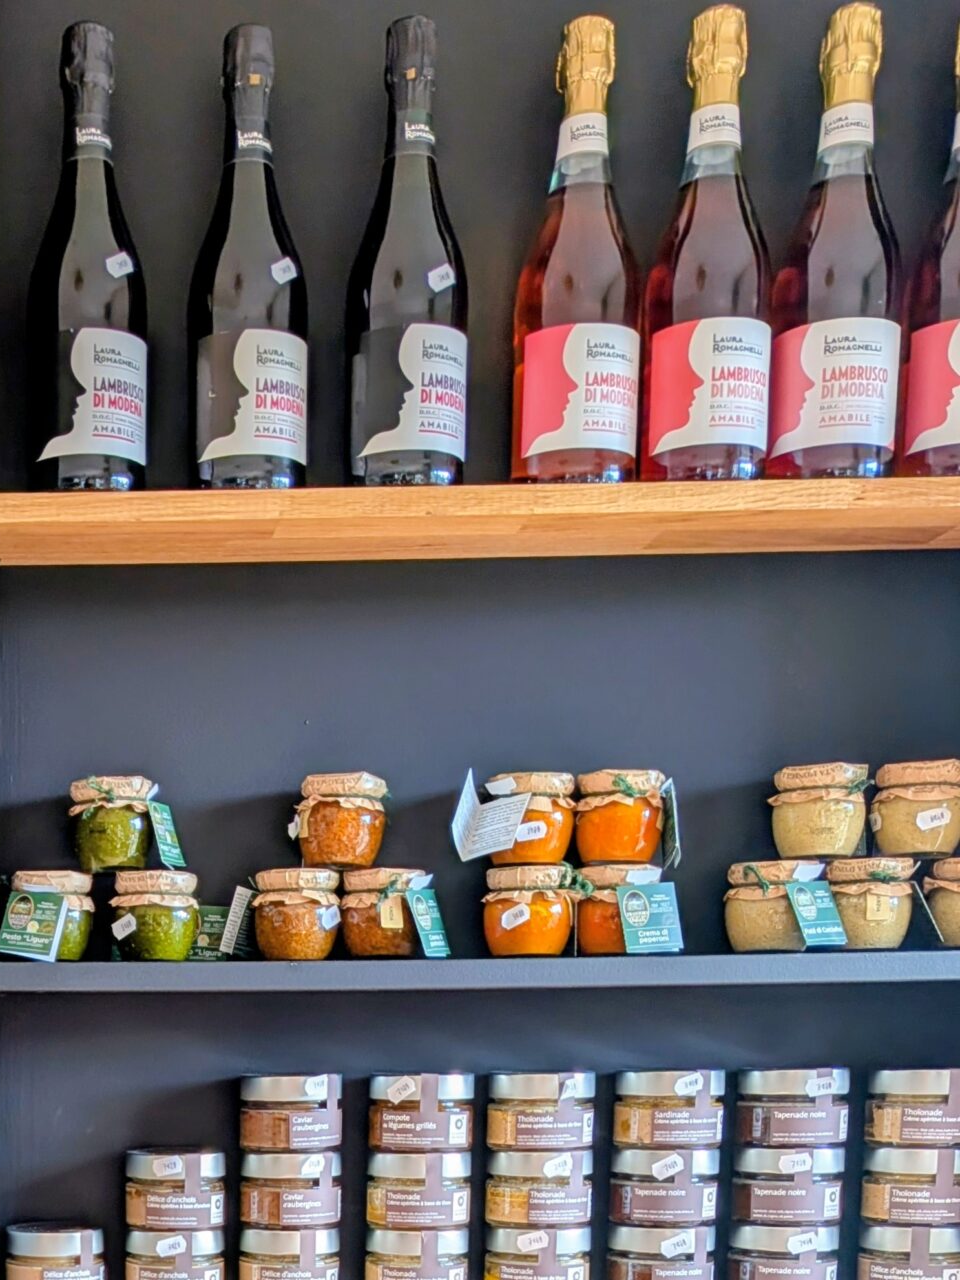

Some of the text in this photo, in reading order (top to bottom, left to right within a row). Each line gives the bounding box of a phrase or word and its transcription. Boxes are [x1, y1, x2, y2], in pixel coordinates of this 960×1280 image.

[711, 366, 766, 387] LAMBRUSCO
[822, 365, 888, 383] LAMBRUSCO
[585, 388, 597, 403] DI
[711, 383, 764, 403] DI MODENA
[821, 382, 884, 399] DI MODENA
[94, 393, 104, 408] DI
[256, 394, 267, 409] DI
[421, 389, 431, 404] DI
[710, 414, 755, 424] AMABILE
[820, 414, 870, 423] AMABILE
[419, 420, 461, 434] AMABILE
[583, 420, 626, 431] AMABILE
[93, 425, 134, 439] AMABILE
[255, 426, 296, 438] AMABILE
[638, 929, 658, 937] Crema
[292, 1116, 313, 1124] Caviar
[383, 1113, 410, 1123] Compote
[517, 1114, 554, 1123] Tholonade
[774, 1111, 827, 1120] Tapenade noire
[388, 1122, 436, 1130] légumes grillés
[283, 1193, 304, 1201] Caviar
[387, 1192, 421, 1201] Tholonade
[530, 1190, 566, 1199] Tholonade
[634, 1188, 686, 1197] Tapenade noire
[754, 1188, 806, 1197] Tapenade noire
[146, 1194, 196, 1203] Délice d'anchois
[43, 1270, 91, 1278] Délice d'anchois
[383, 1269, 417, 1278] Tholonade
[758, 1266, 811, 1276] Tapenade noire
